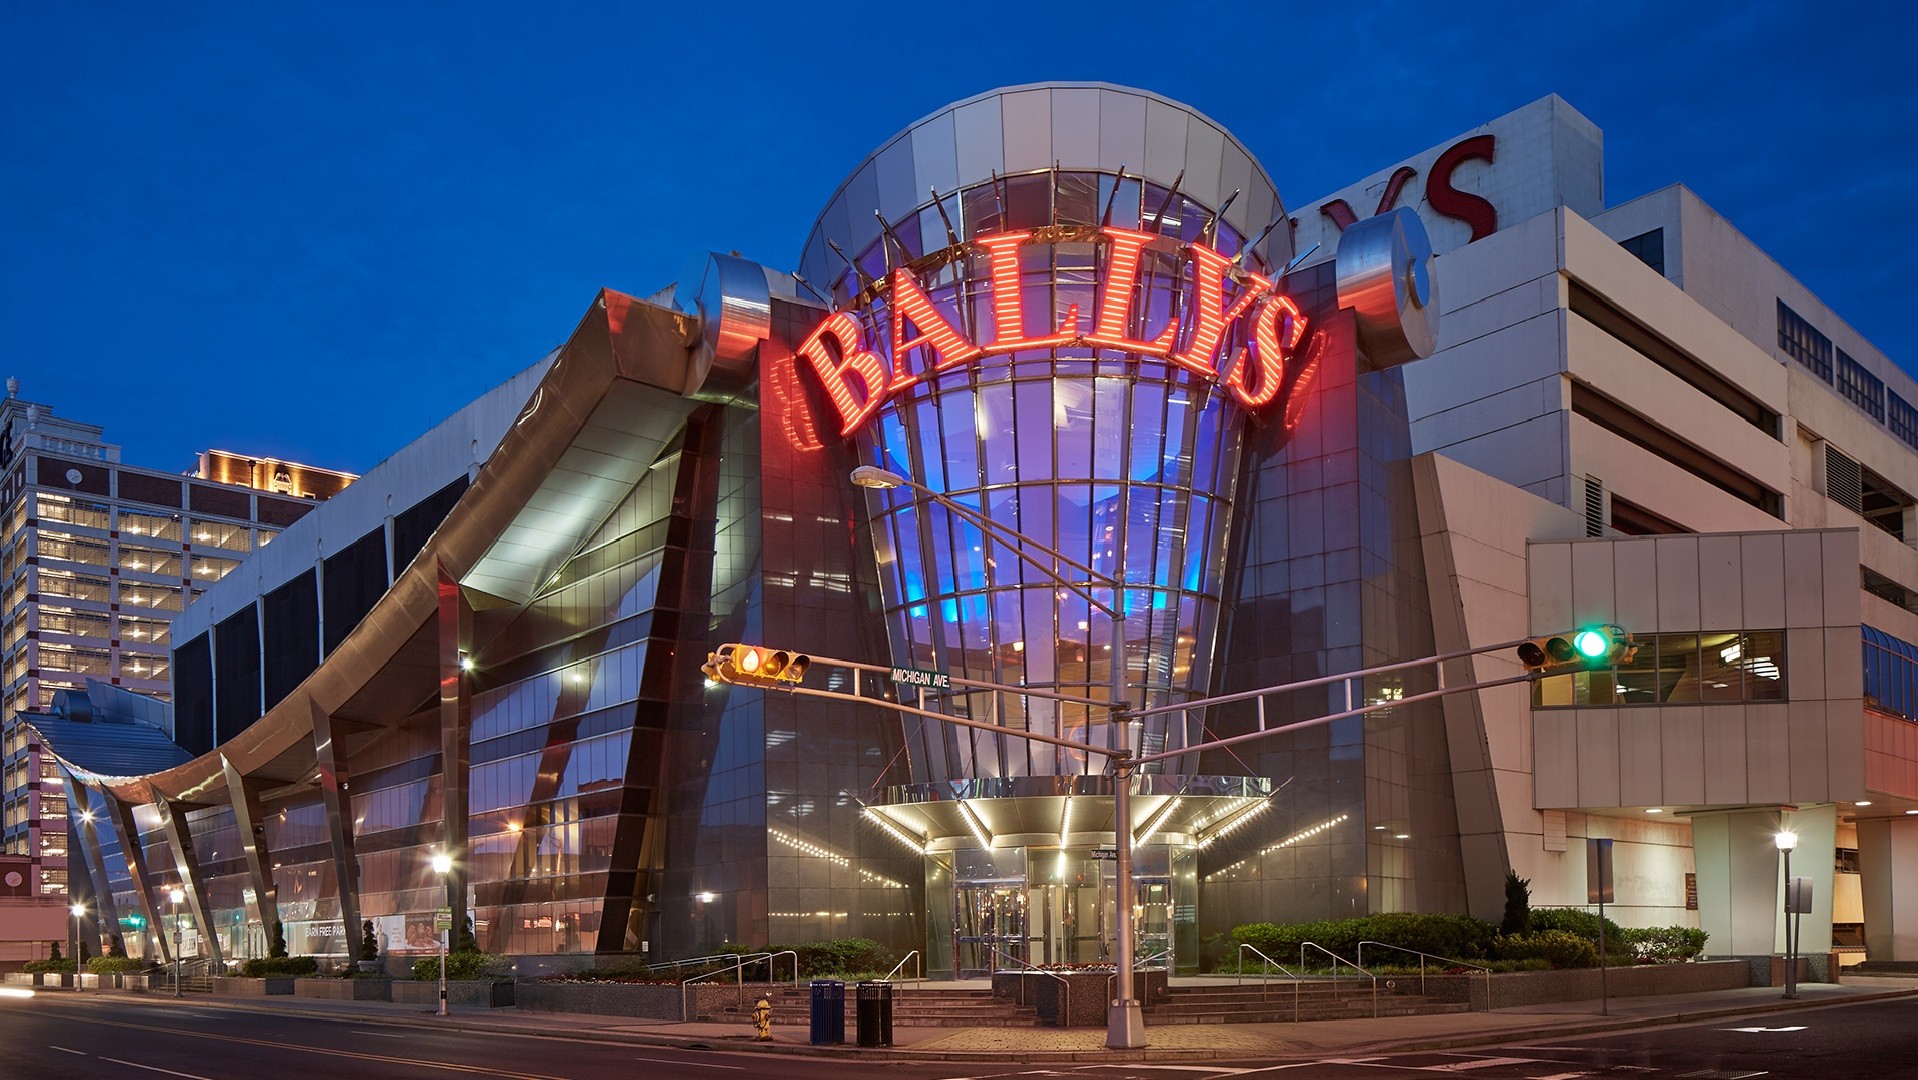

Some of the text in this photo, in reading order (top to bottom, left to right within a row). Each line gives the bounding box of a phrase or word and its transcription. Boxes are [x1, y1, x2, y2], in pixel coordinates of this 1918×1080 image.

[893, 668, 950, 688] MICHIGAN AVE.
[1091, 850, 1108, 859] Michigan
[306, 926, 318, 937] EARN
[319, 926, 332, 937] FREE
